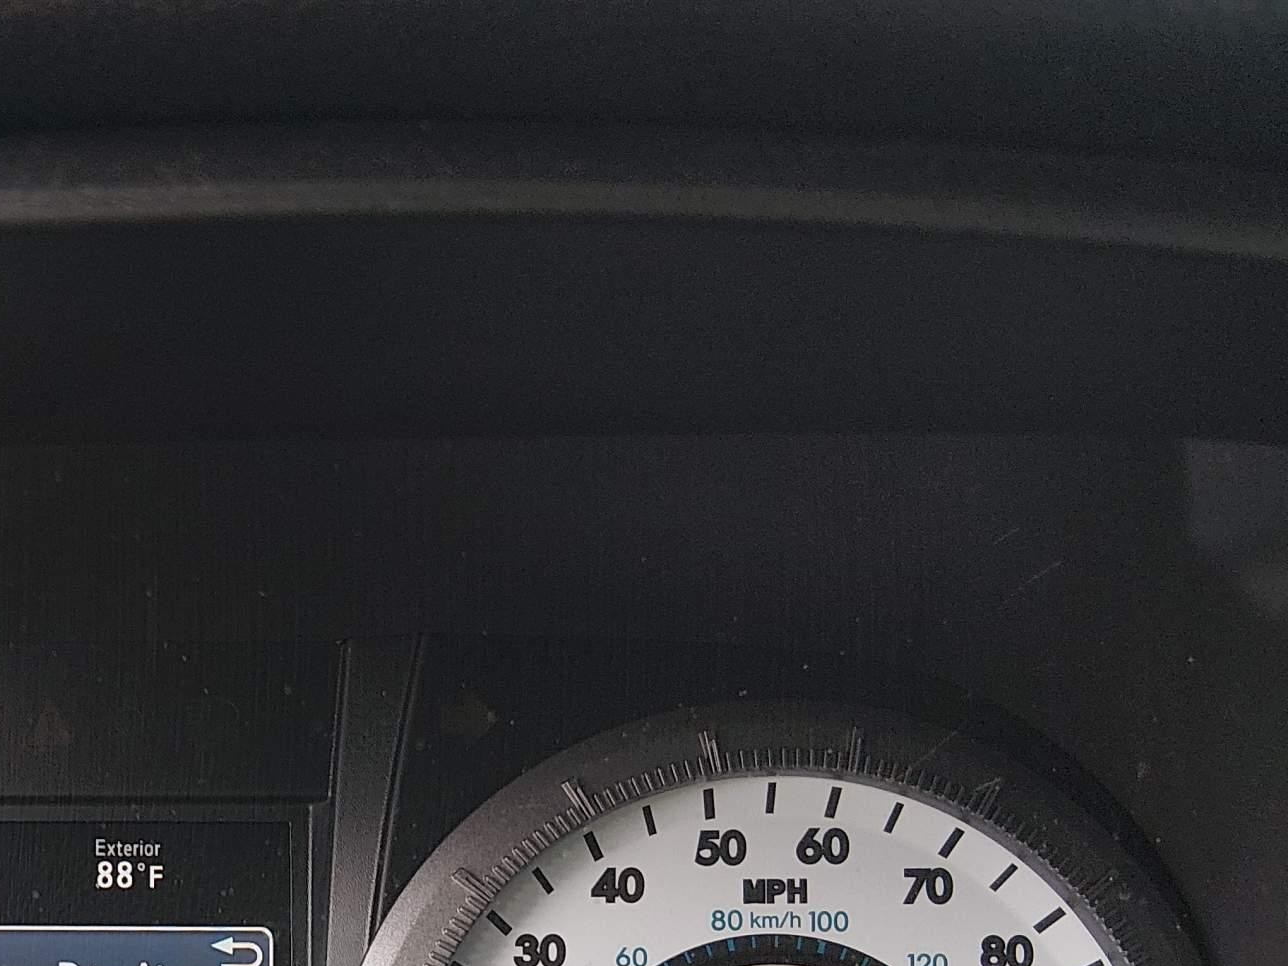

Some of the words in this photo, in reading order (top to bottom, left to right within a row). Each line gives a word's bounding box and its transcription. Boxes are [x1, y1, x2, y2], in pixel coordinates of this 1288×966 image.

[95, 838, 161, 857] Exterior
[695, 829, 747, 866] 50
[796, 828, 850, 865] 60
[96, 861, 164, 888] 88°F
[591, 867, 645, 903] 40
[902, 868, 954, 905] 70
[742, 878, 808, 904] MPH
[711, 910, 743, 932] 80
[749, 911, 802, 929] km/h
[809, 911, 849, 932] 100
